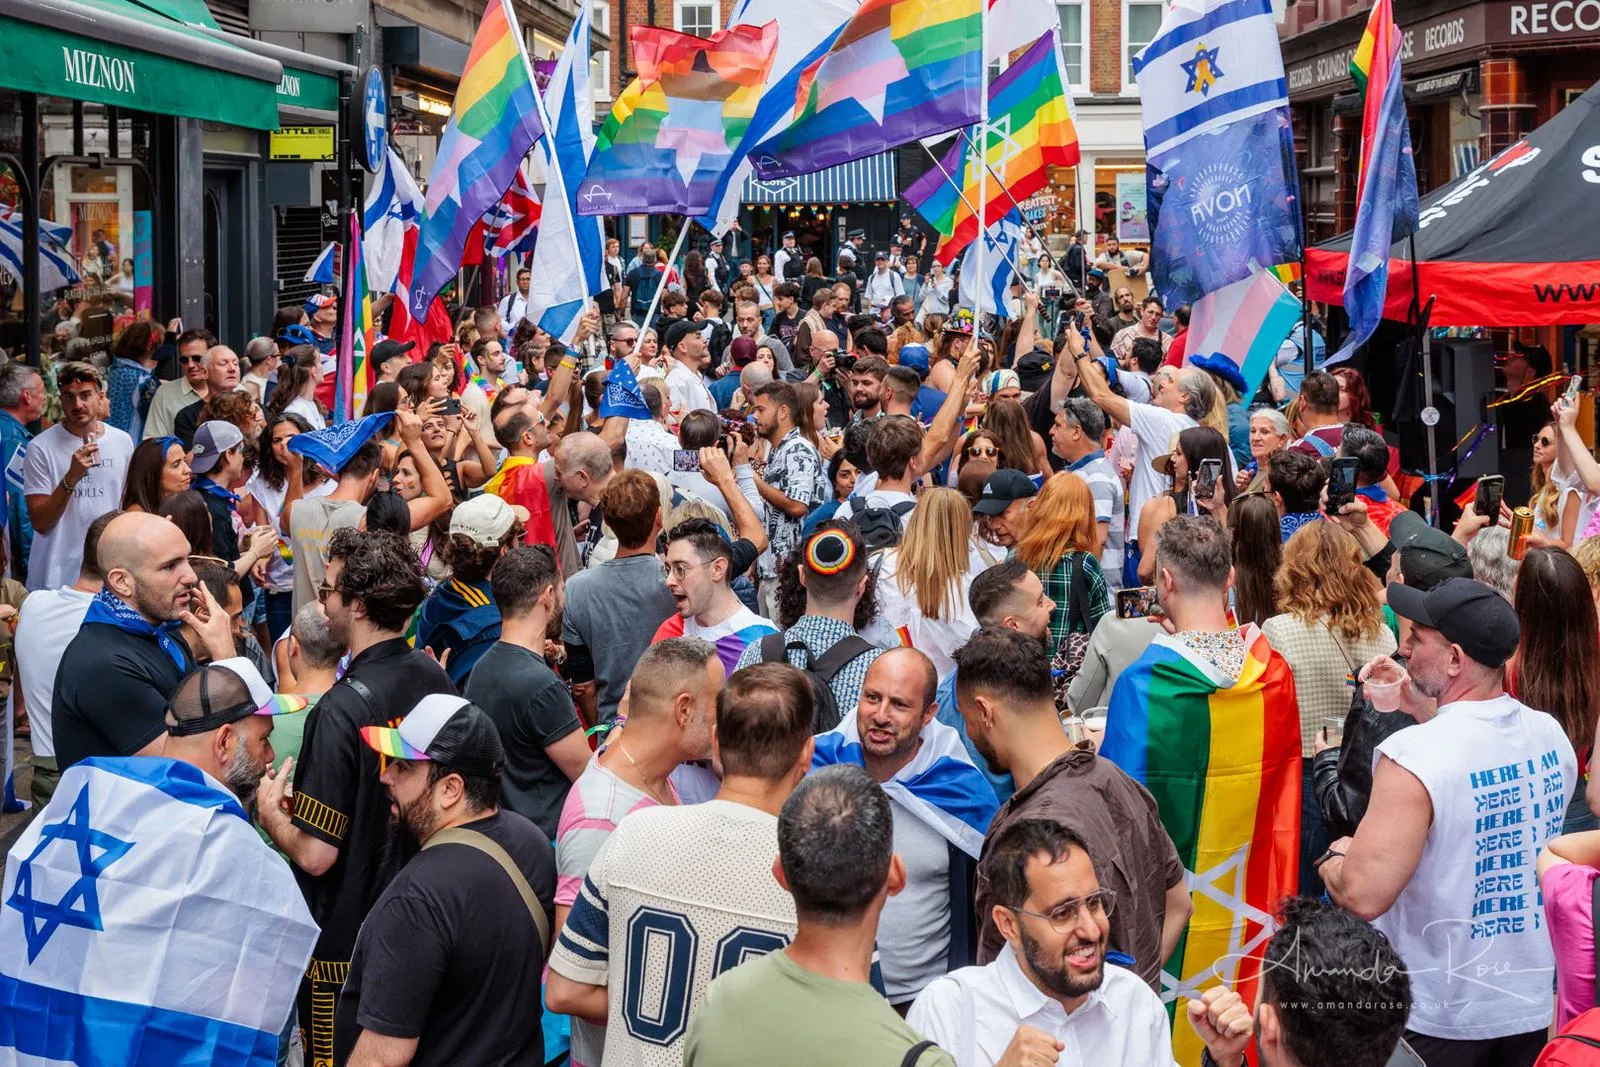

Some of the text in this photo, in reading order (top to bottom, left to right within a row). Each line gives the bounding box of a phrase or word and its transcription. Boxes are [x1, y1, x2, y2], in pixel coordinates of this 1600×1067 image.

[1317, 53, 1345, 82] SOUNDS
[1425, 18, 1464, 52] RECORDS
[62, 46, 135, 94] MIZNON
[1470, 750, 1559, 789] HERE I AM
[1474, 786, 1521, 813] HERE
[1476, 794, 1563, 834] HERE I AM
[1475, 829, 1522, 856] HERE
[1475, 850, 1528, 877] HERE
[1475, 873, 1523, 898] HERE
[1472, 893, 1529, 918] HERE
[1471, 916, 1525, 939] HERE
